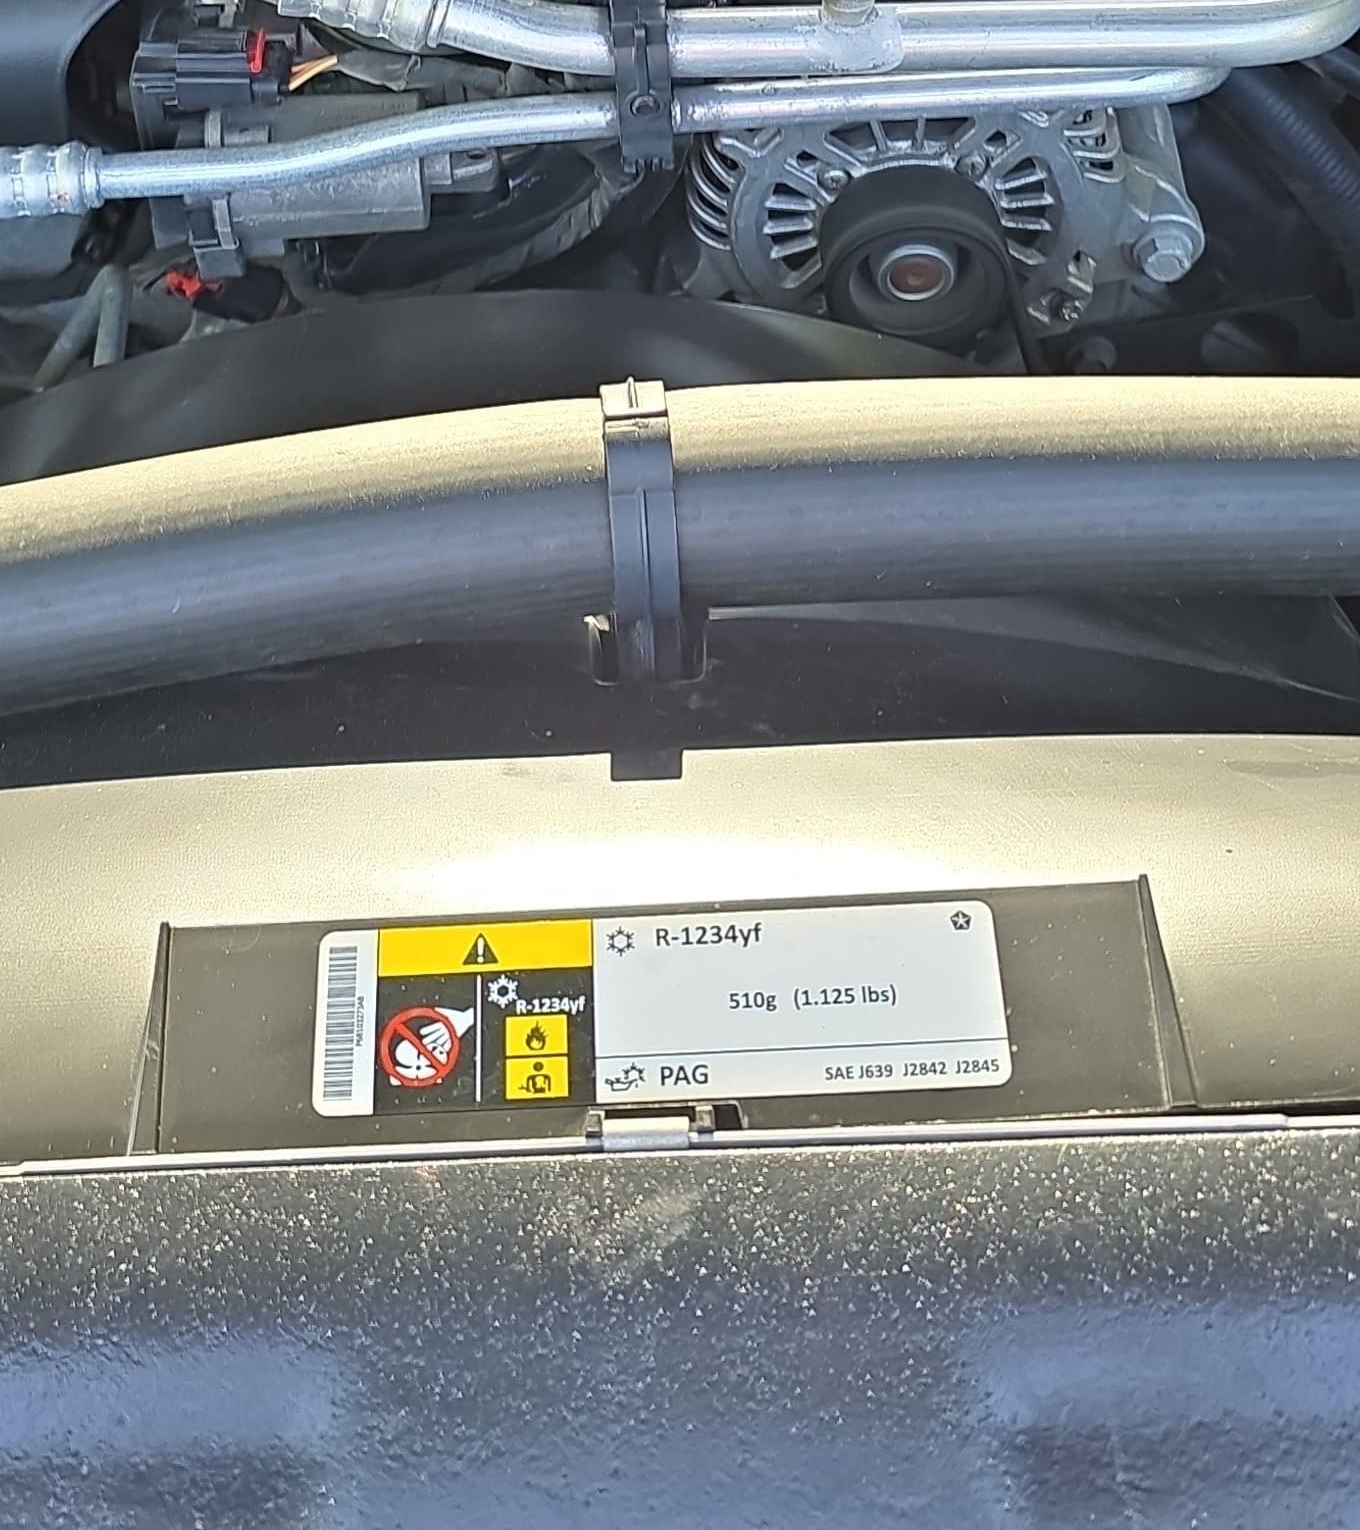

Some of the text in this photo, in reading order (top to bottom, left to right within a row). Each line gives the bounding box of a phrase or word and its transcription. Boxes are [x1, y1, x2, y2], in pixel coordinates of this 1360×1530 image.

[654, 921, 764, 948] R-1234yf
[515, 995, 587, 1015] R-1234yf
[728, 983, 898, 1013] 510g (1.125 lbs)
[659, 1058, 1001, 1087] PAG SAE J639 J2842 J2845
